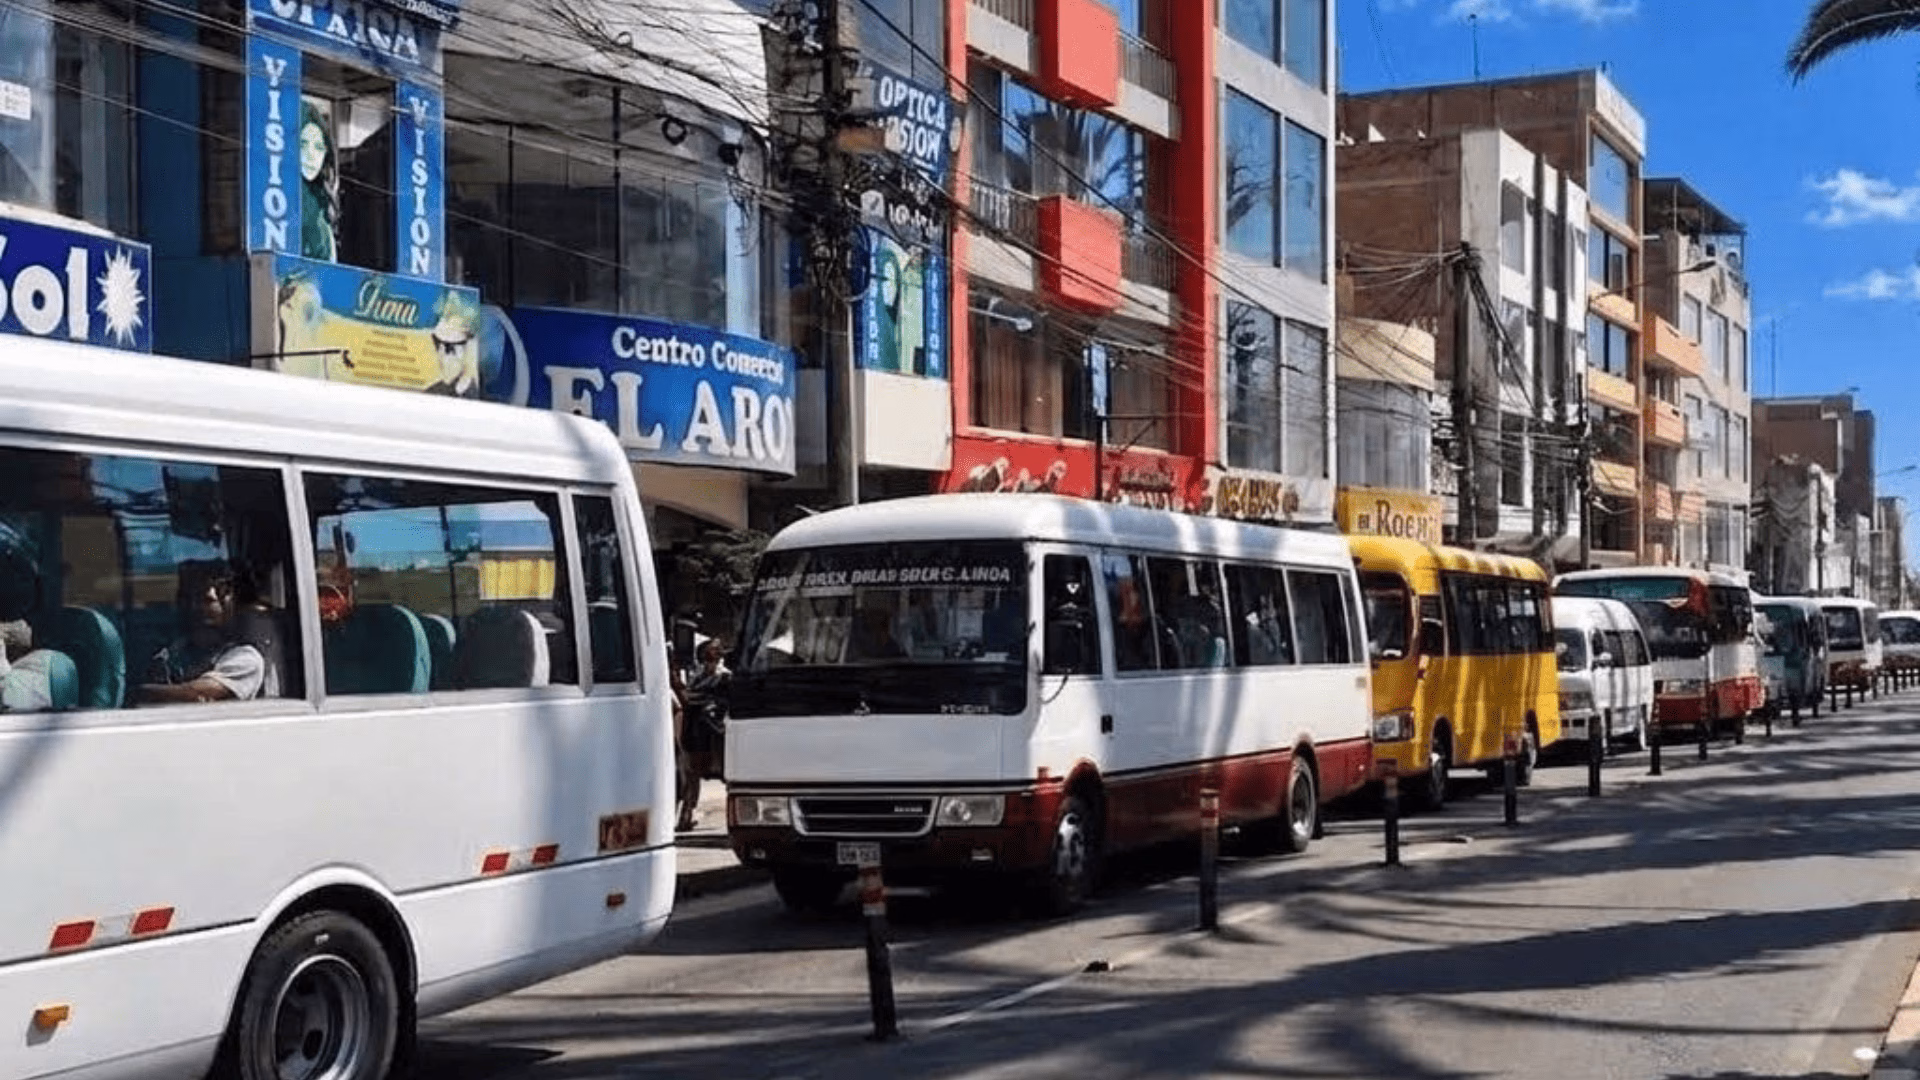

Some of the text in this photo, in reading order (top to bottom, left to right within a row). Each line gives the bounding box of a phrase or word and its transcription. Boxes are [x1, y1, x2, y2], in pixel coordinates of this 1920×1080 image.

[262, 53, 288, 250] VISION
[879, 76, 946, 131] OPTICA
[409, 96, 430, 275] VISION
[0, 234, 89, 341] ol
[612, 326, 706, 368] Centro
[544, 365, 664, 450] EL
